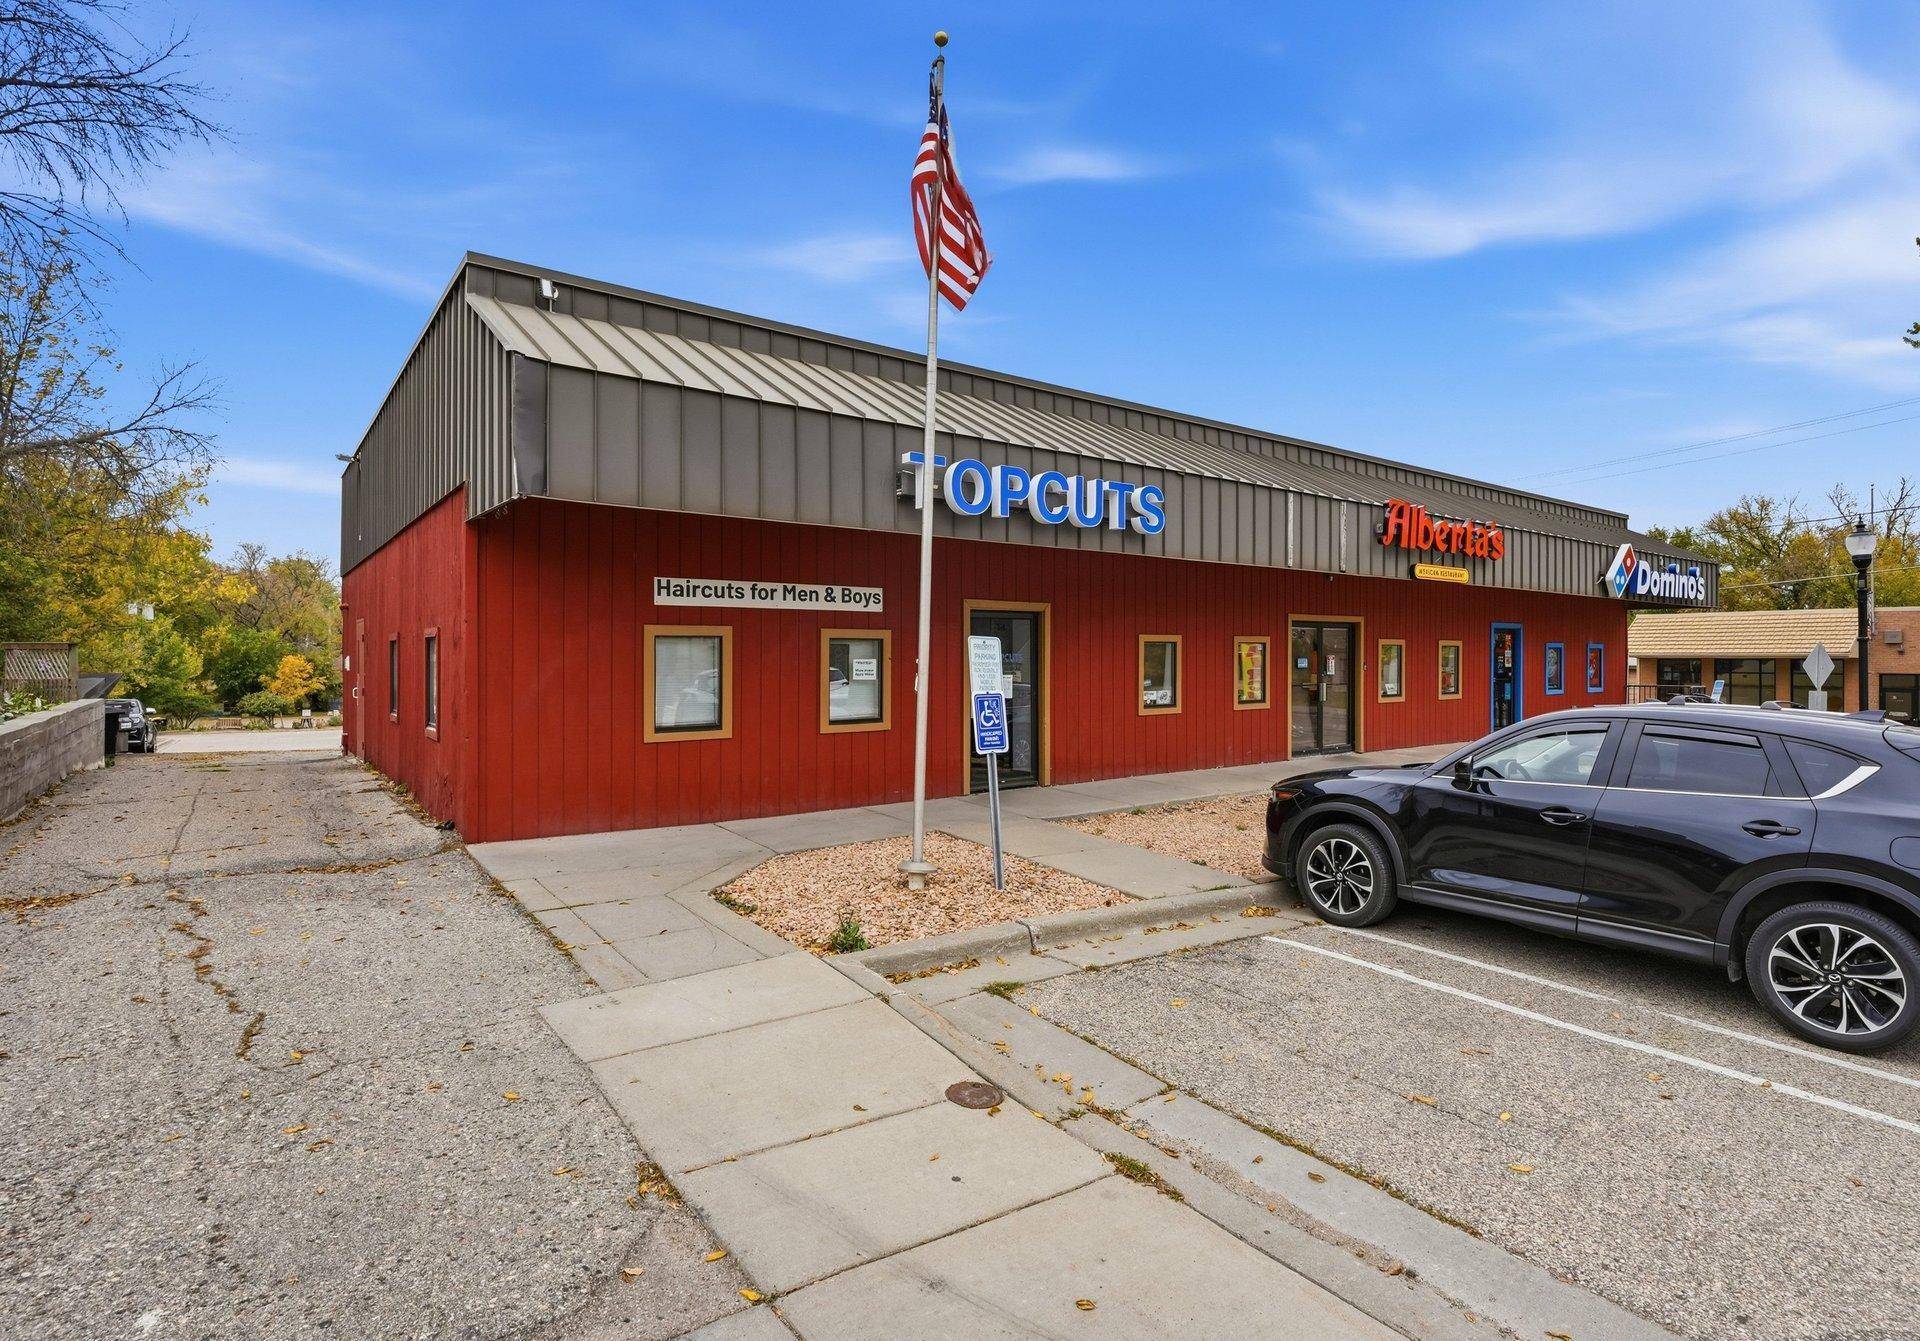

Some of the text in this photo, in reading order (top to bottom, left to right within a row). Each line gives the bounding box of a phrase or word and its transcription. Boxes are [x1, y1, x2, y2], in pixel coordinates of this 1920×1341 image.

[902, 451, 1166, 535] TOPCUTS
[1382, 497, 1504, 560] Alberta's
[656, 579, 882, 607] Haircuts for Men & Boys
[1637, 560, 1705, 600] Domino's
